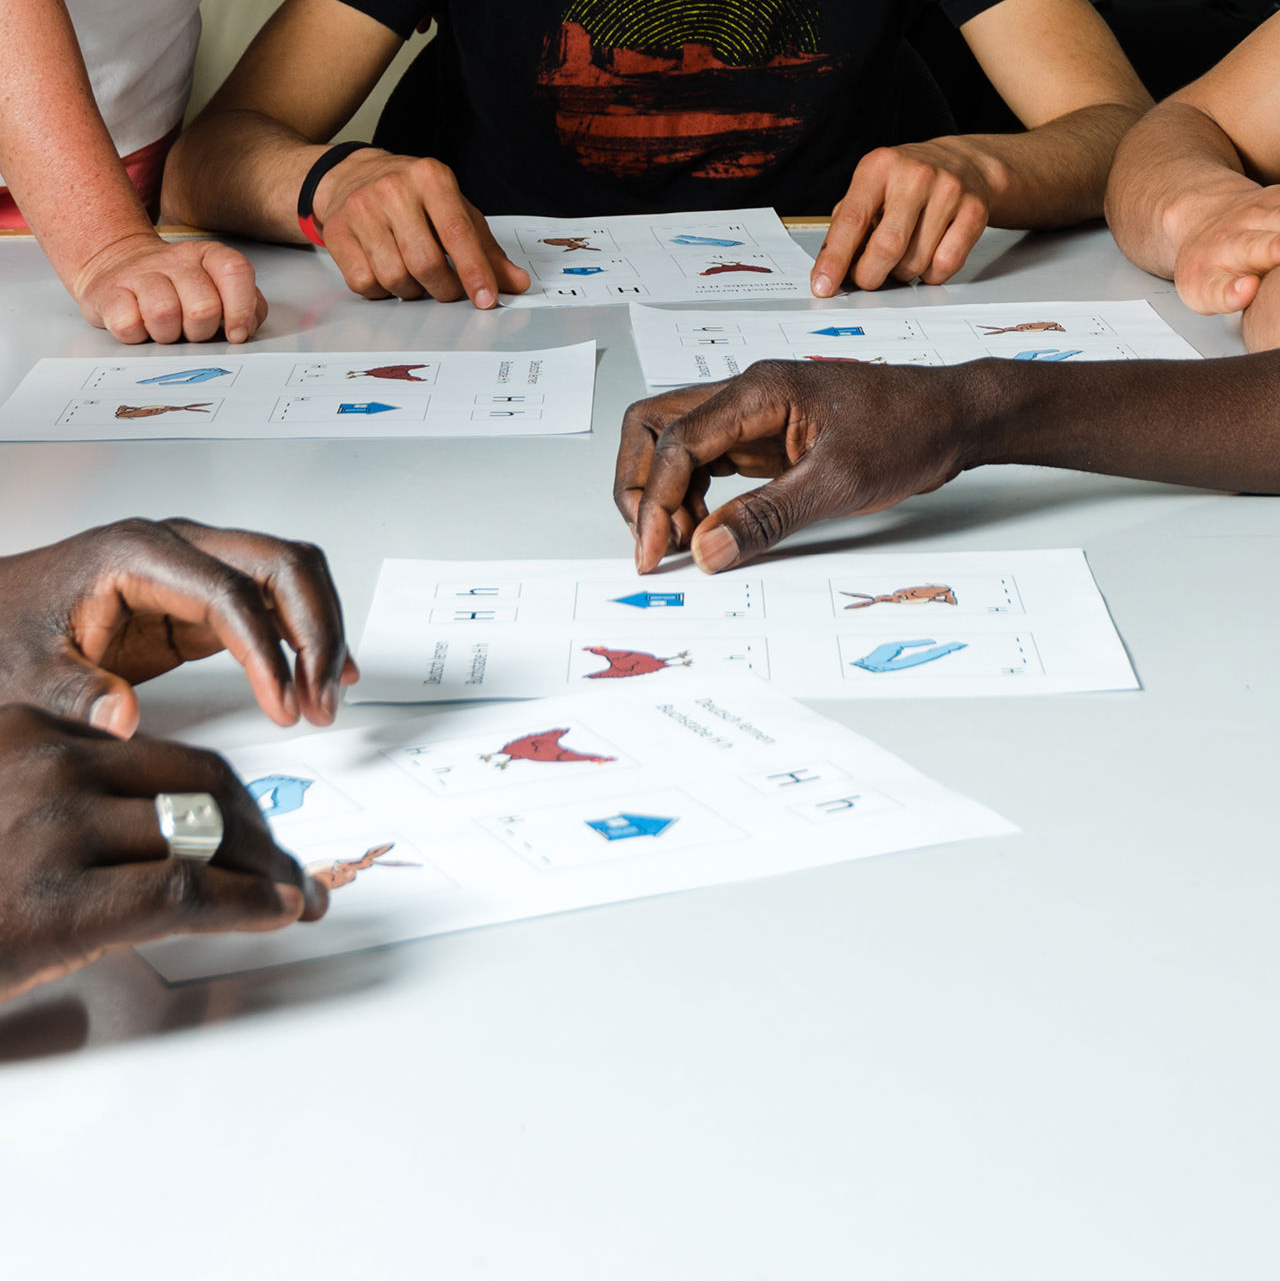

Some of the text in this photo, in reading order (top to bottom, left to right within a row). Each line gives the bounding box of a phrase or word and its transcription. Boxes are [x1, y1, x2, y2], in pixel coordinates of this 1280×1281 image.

[455, 587, 499, 596] h
[453, 610, 496, 621] H
[656, 703, 713, 738] Buchstabe
[694, 697, 776, 744] Deutsch lernen
[766, 768, 821, 787] H
[815, 794, 862, 814] h
